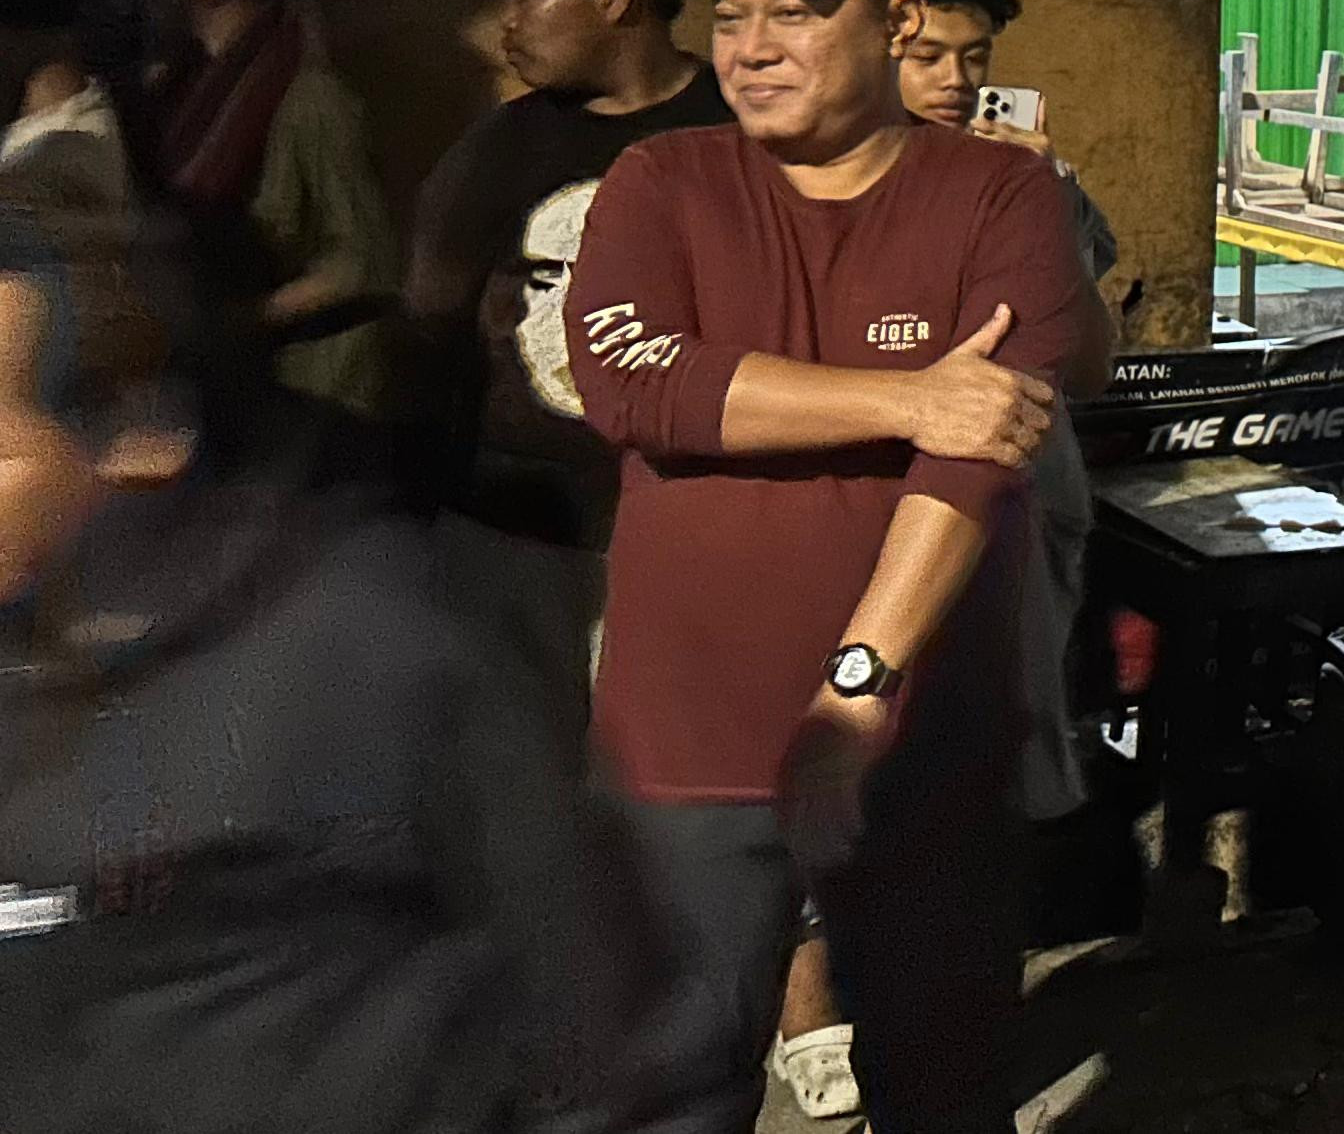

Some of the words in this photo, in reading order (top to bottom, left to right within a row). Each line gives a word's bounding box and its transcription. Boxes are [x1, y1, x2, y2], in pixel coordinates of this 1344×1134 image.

[867, 321, 929, 343] EIGER
[1114, 363, 1172, 382] ATAN:
[1144, 415, 1225, 455] THE
